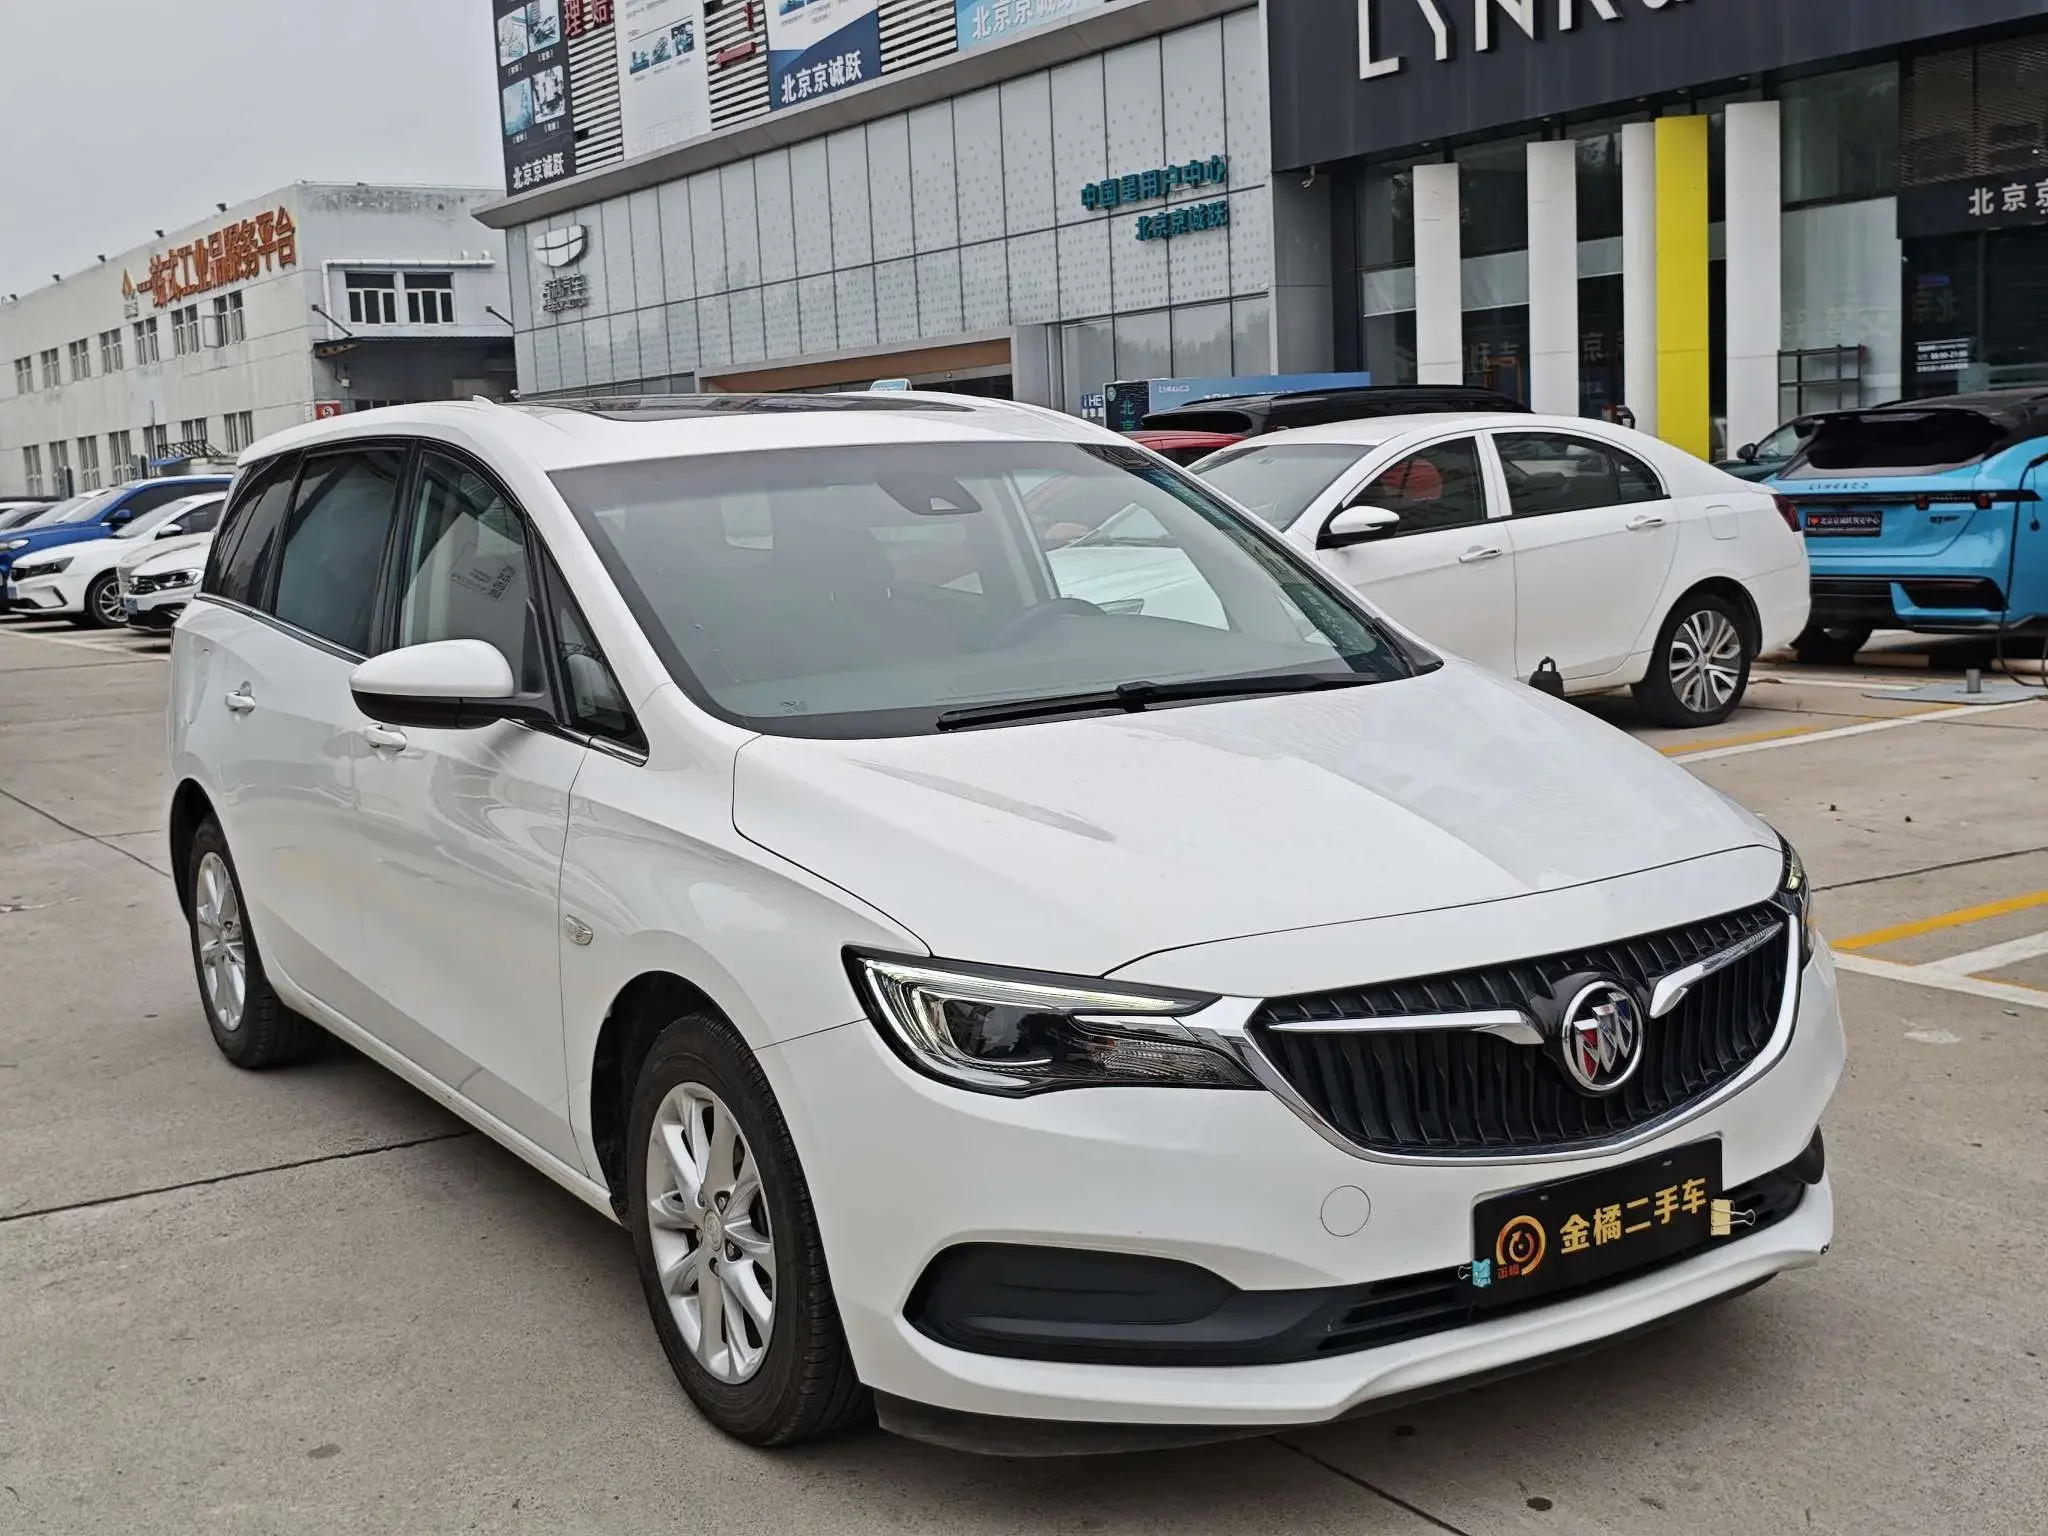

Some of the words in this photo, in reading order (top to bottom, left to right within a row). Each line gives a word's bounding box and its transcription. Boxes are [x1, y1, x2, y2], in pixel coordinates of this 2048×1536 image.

[972, 0, 1079, 40] 北京京
[781, 50, 863, 104] 北京京诚跃
[513, 152, 565, 189] 北京京诚跃
[1081, 155, 1226, 211] 中国星用户中心
[1559, 1177, 1706, 1254] 金橘二手车
